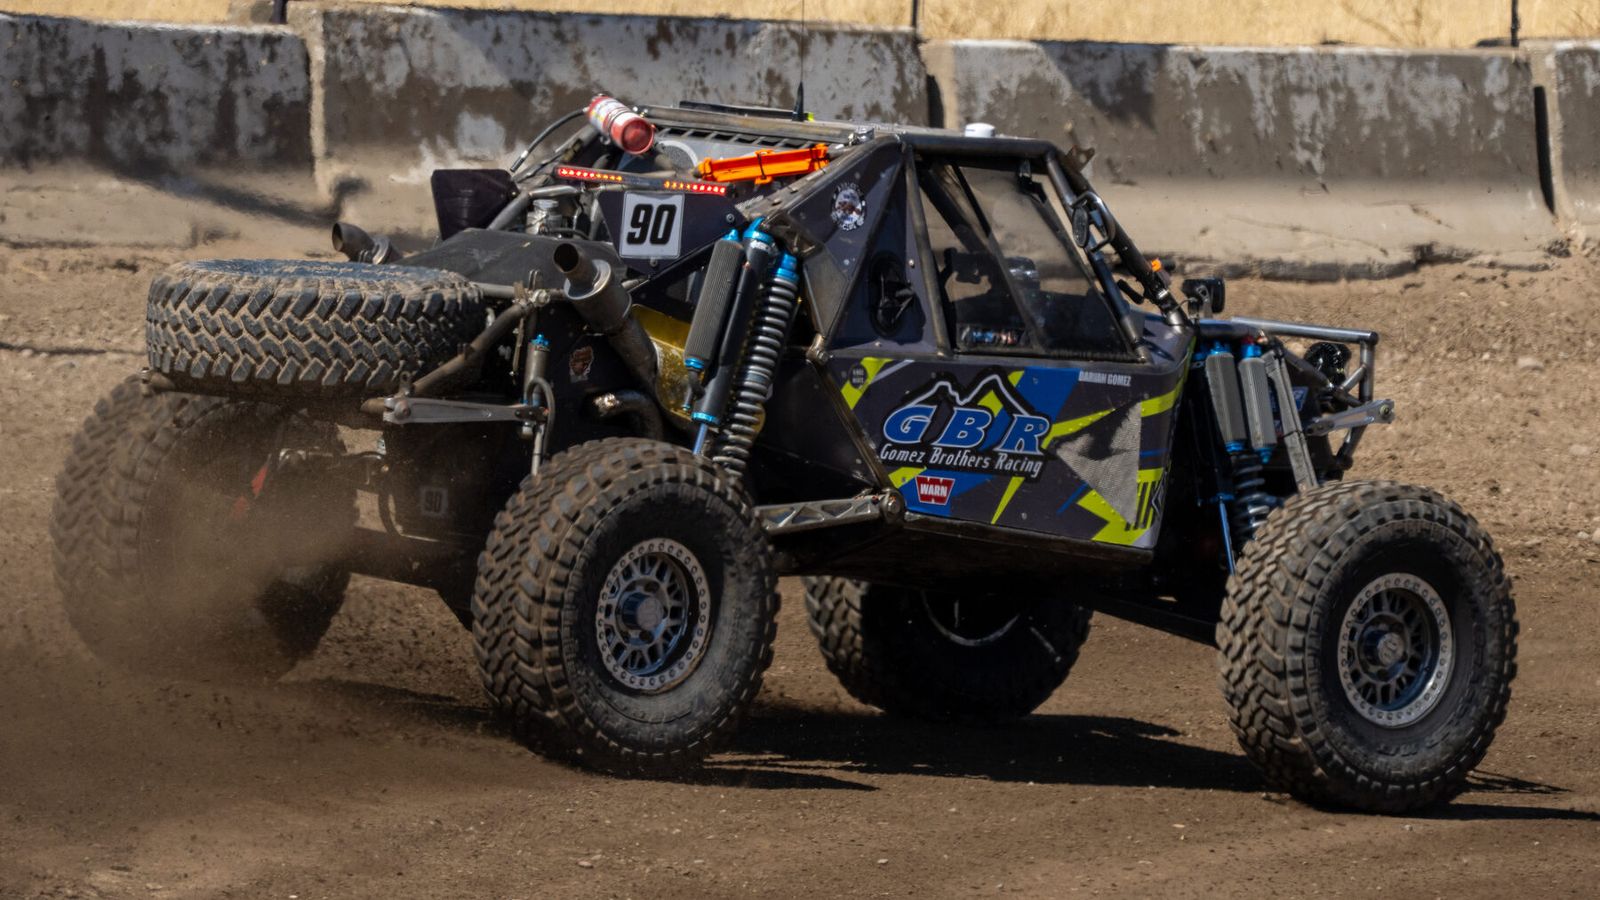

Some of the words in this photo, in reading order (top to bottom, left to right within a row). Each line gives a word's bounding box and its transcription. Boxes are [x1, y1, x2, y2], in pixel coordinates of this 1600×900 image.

[627, 204, 677, 245] 90
[1107, 373, 1131, 387] GOMEZ
[883, 404, 1050, 455] GBR
[880, 443, 927, 463] Gomez
[929, 447, 990, 469] Brothers
[994, 453, 1043, 478] Racing
[919, 483, 949, 497] WARN
